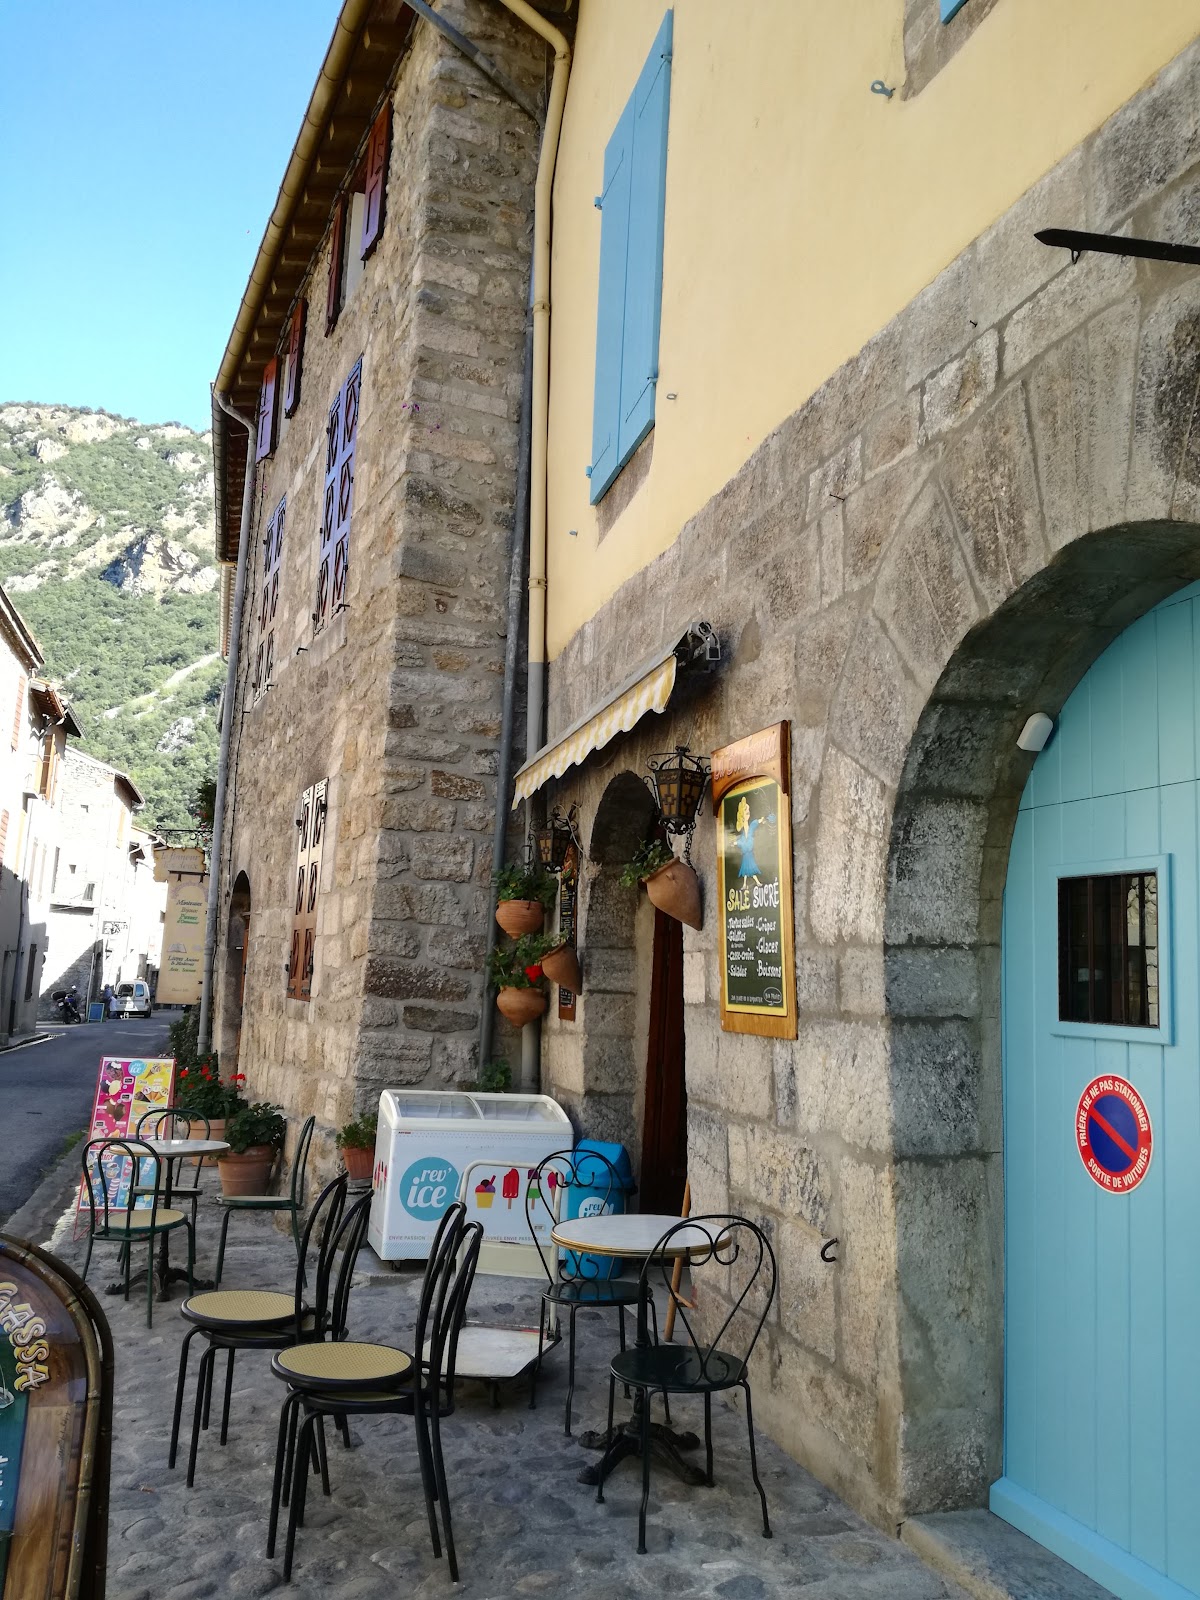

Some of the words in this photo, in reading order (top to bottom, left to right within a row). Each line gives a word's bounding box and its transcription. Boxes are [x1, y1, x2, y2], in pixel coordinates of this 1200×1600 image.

[726, 885, 751, 912] SALÉ
[752, 876, 780, 909] SUCRÉ
[1082, 1095, 1092, 1110] DE
[1089, 1084, 1100, 1099] NE
[1099, 1080, 1113, 1092] PAS
[1114, 1081, 1148, 1132] STATIONNER
[1078, 1108, 1088, 1147] PRIÈRE
[1087, 1158, 1111, 1186] SORTIE
[1112, 1177, 1122, 1188] DE
[1122, 1147, 1149, 1187] VOITURES
[406, 1176, 447, 1208] ice
